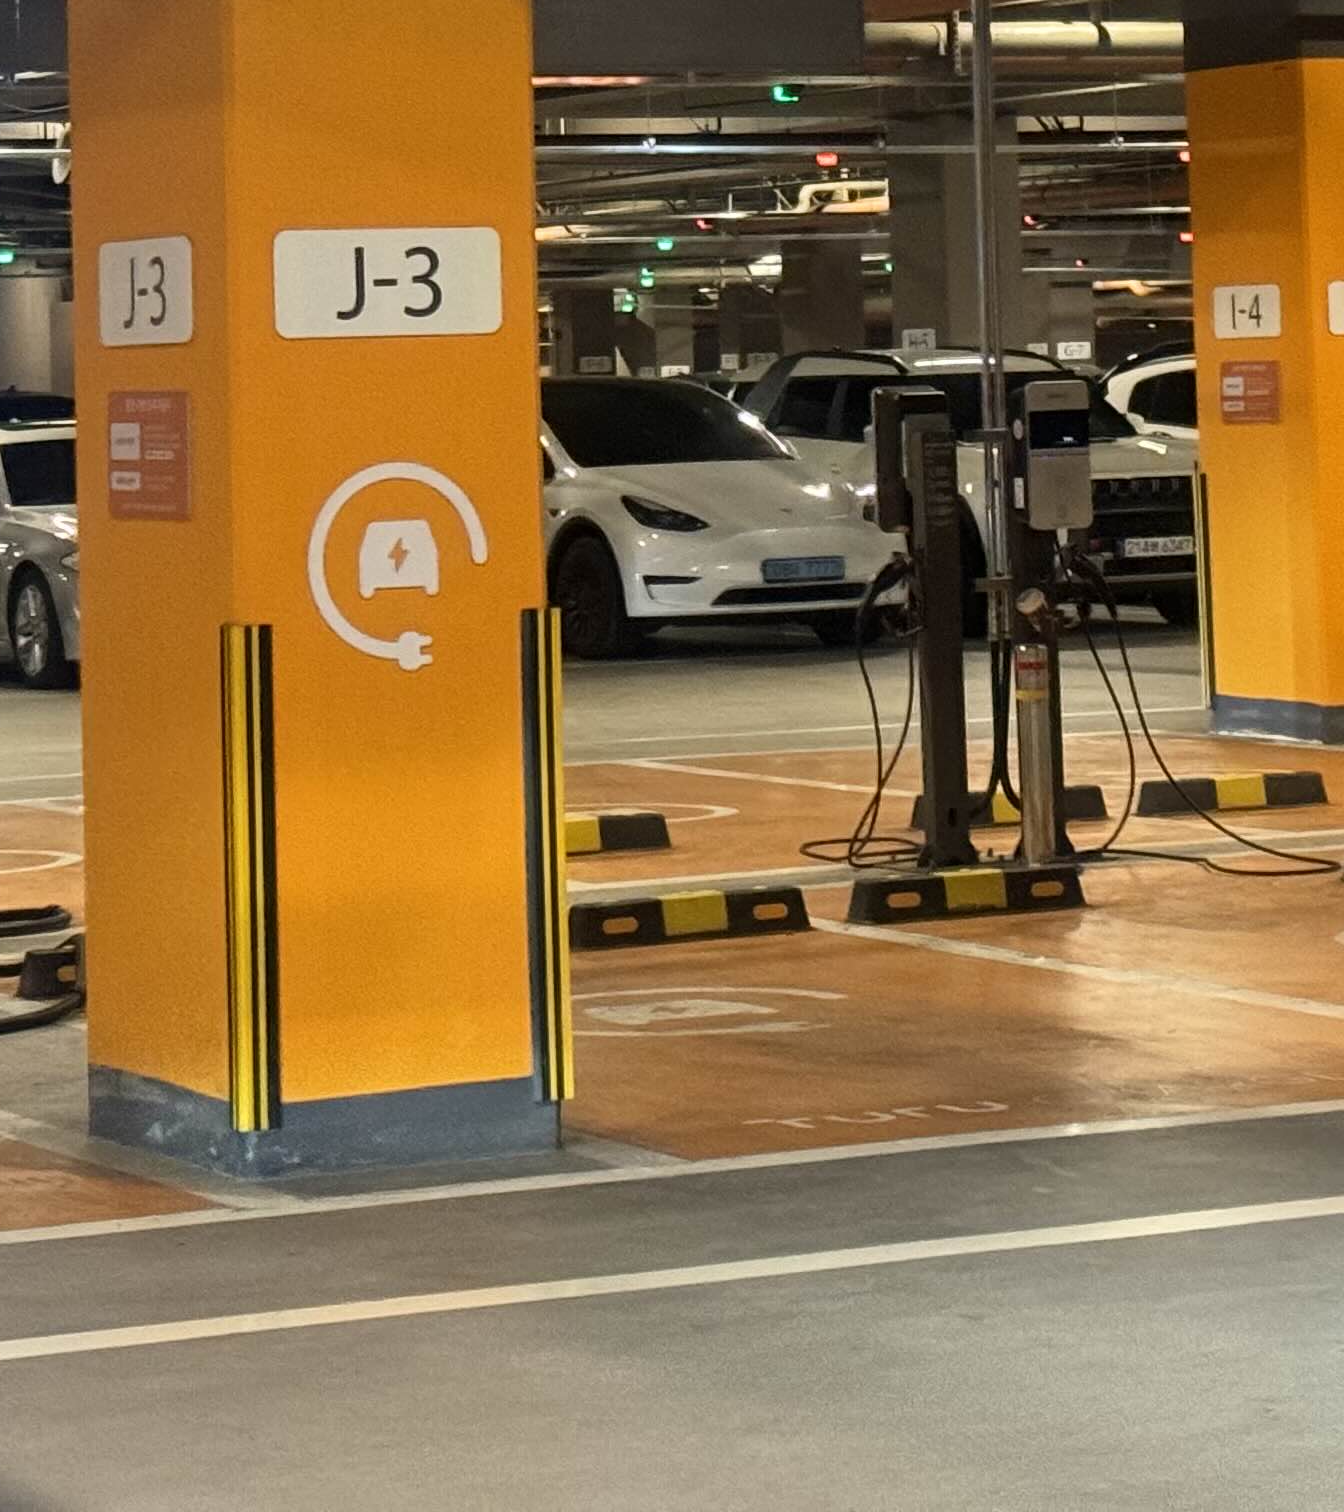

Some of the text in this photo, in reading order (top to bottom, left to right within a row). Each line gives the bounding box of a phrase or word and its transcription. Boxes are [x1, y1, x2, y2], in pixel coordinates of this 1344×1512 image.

[123, 255, 168, 329] J-3
[335, 245, 443, 322] J-3
[1231, 293, 1262, 330] I-4
